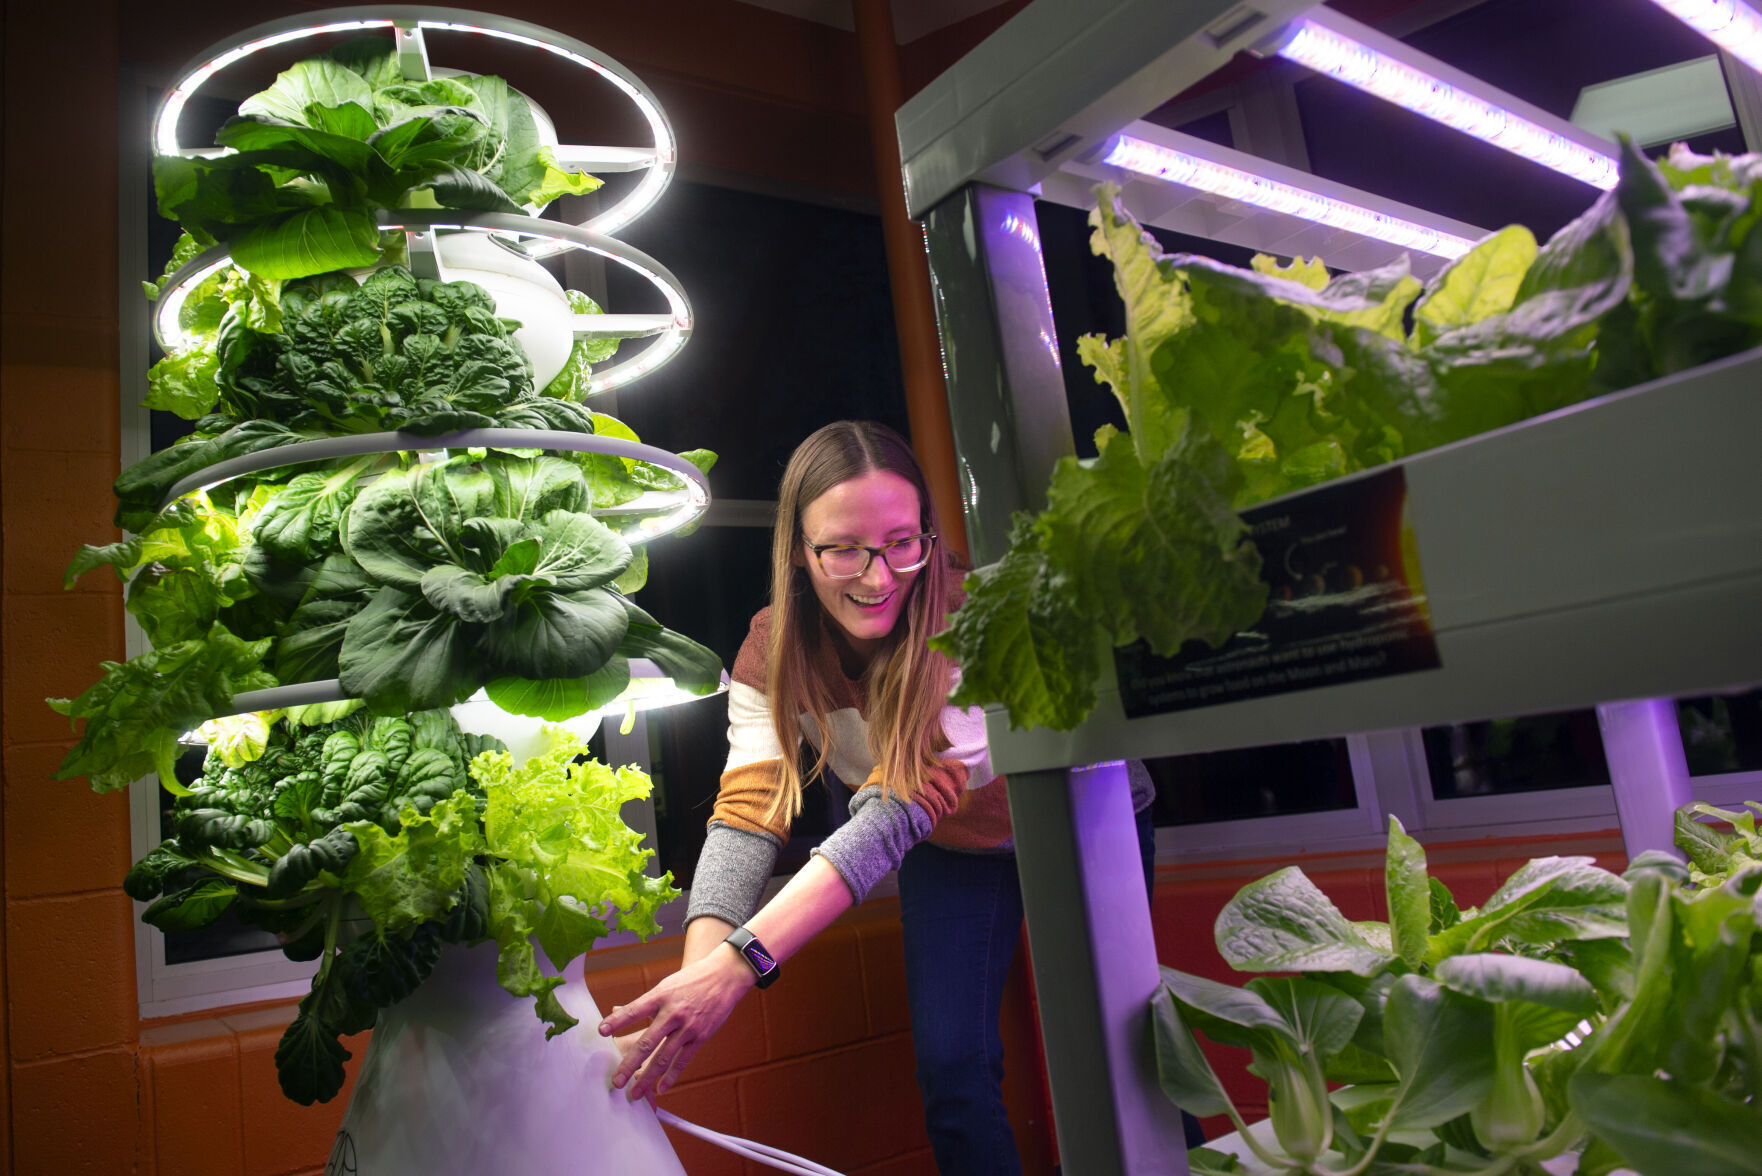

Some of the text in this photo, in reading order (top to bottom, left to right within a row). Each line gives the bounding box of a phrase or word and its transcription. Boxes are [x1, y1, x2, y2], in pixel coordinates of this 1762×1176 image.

[1250, 515, 1290, 535] YSTEM
[1301, 645, 1315, 659] to
[1317, 643, 1338, 656] use
[1323, 659, 1347, 675] and
